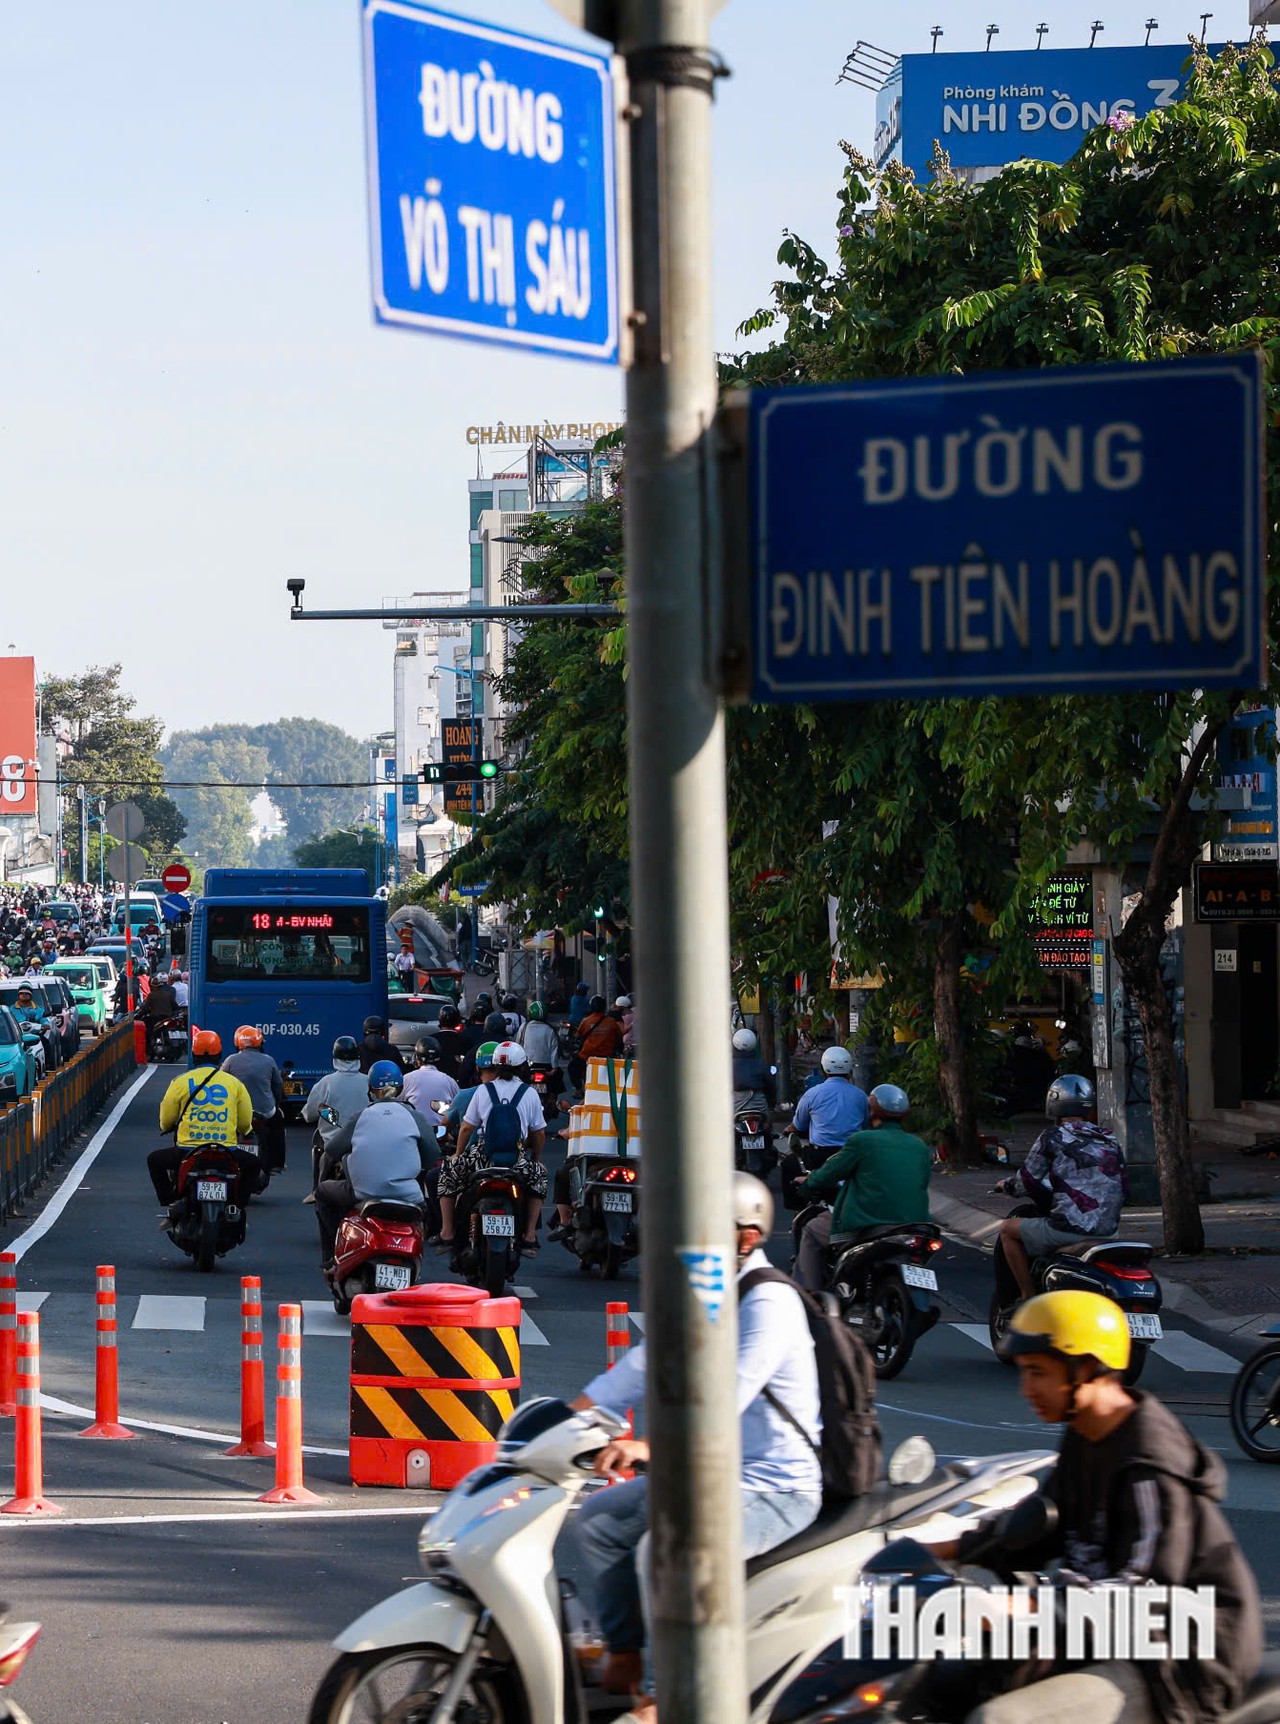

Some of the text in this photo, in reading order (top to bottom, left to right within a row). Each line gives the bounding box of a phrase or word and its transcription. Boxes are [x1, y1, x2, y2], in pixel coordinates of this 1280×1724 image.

[944, 83, 1044, 100] Phòng khám
[418, 60, 563, 164] ĐƯỜNG
[943, 103, 1007, 133] NHI
[399, 177, 591, 328] VÕ THỊ SÁU
[466, 421, 520, 445] CHÂN
[525, 419, 565, 443] MÀY
[859, 414, 1144, 503] ĐƯỜNG
[770, 530, 1240, 659] ĐINH TIÊN HOÀNG
[1064, 881, 1085, 893] GIÀY
[252, 913, 270, 929] 18
[1070, 952, 1086, 964] TẠO
[1217, 953, 1232, 963] 214
[254, 1023, 320, 1036] 50F-030.45
[188, 1078, 228, 1106] be
[189, 1107, 228, 1123] Food
